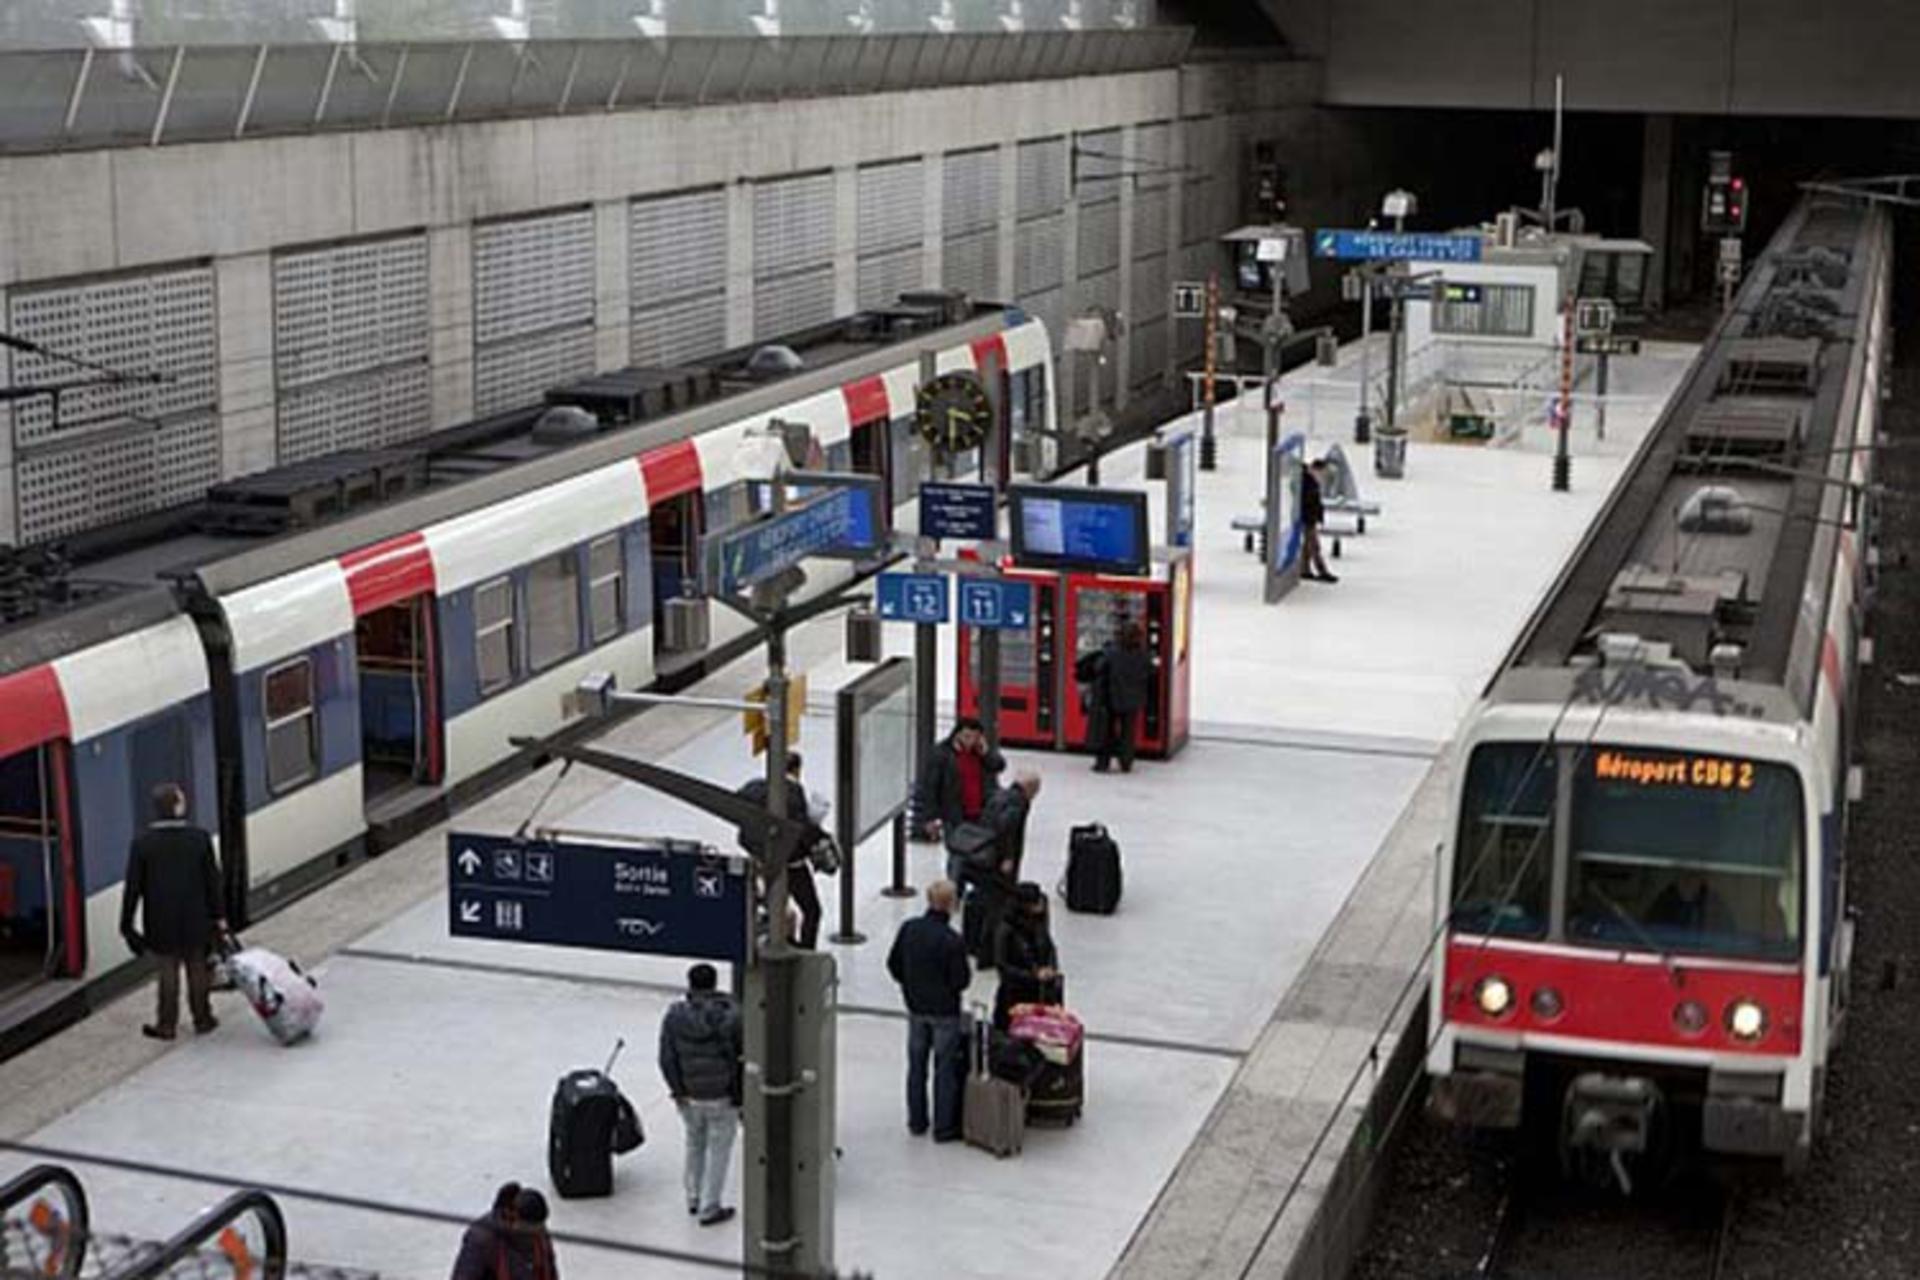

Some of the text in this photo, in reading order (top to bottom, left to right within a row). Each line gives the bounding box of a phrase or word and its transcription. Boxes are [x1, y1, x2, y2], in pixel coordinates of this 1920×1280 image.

[912, 593, 937, 615] 12
[971, 598, 995, 619] 11
[1738, 761, 1754, 790] 2
[614, 862, 667, 883] Sortie
